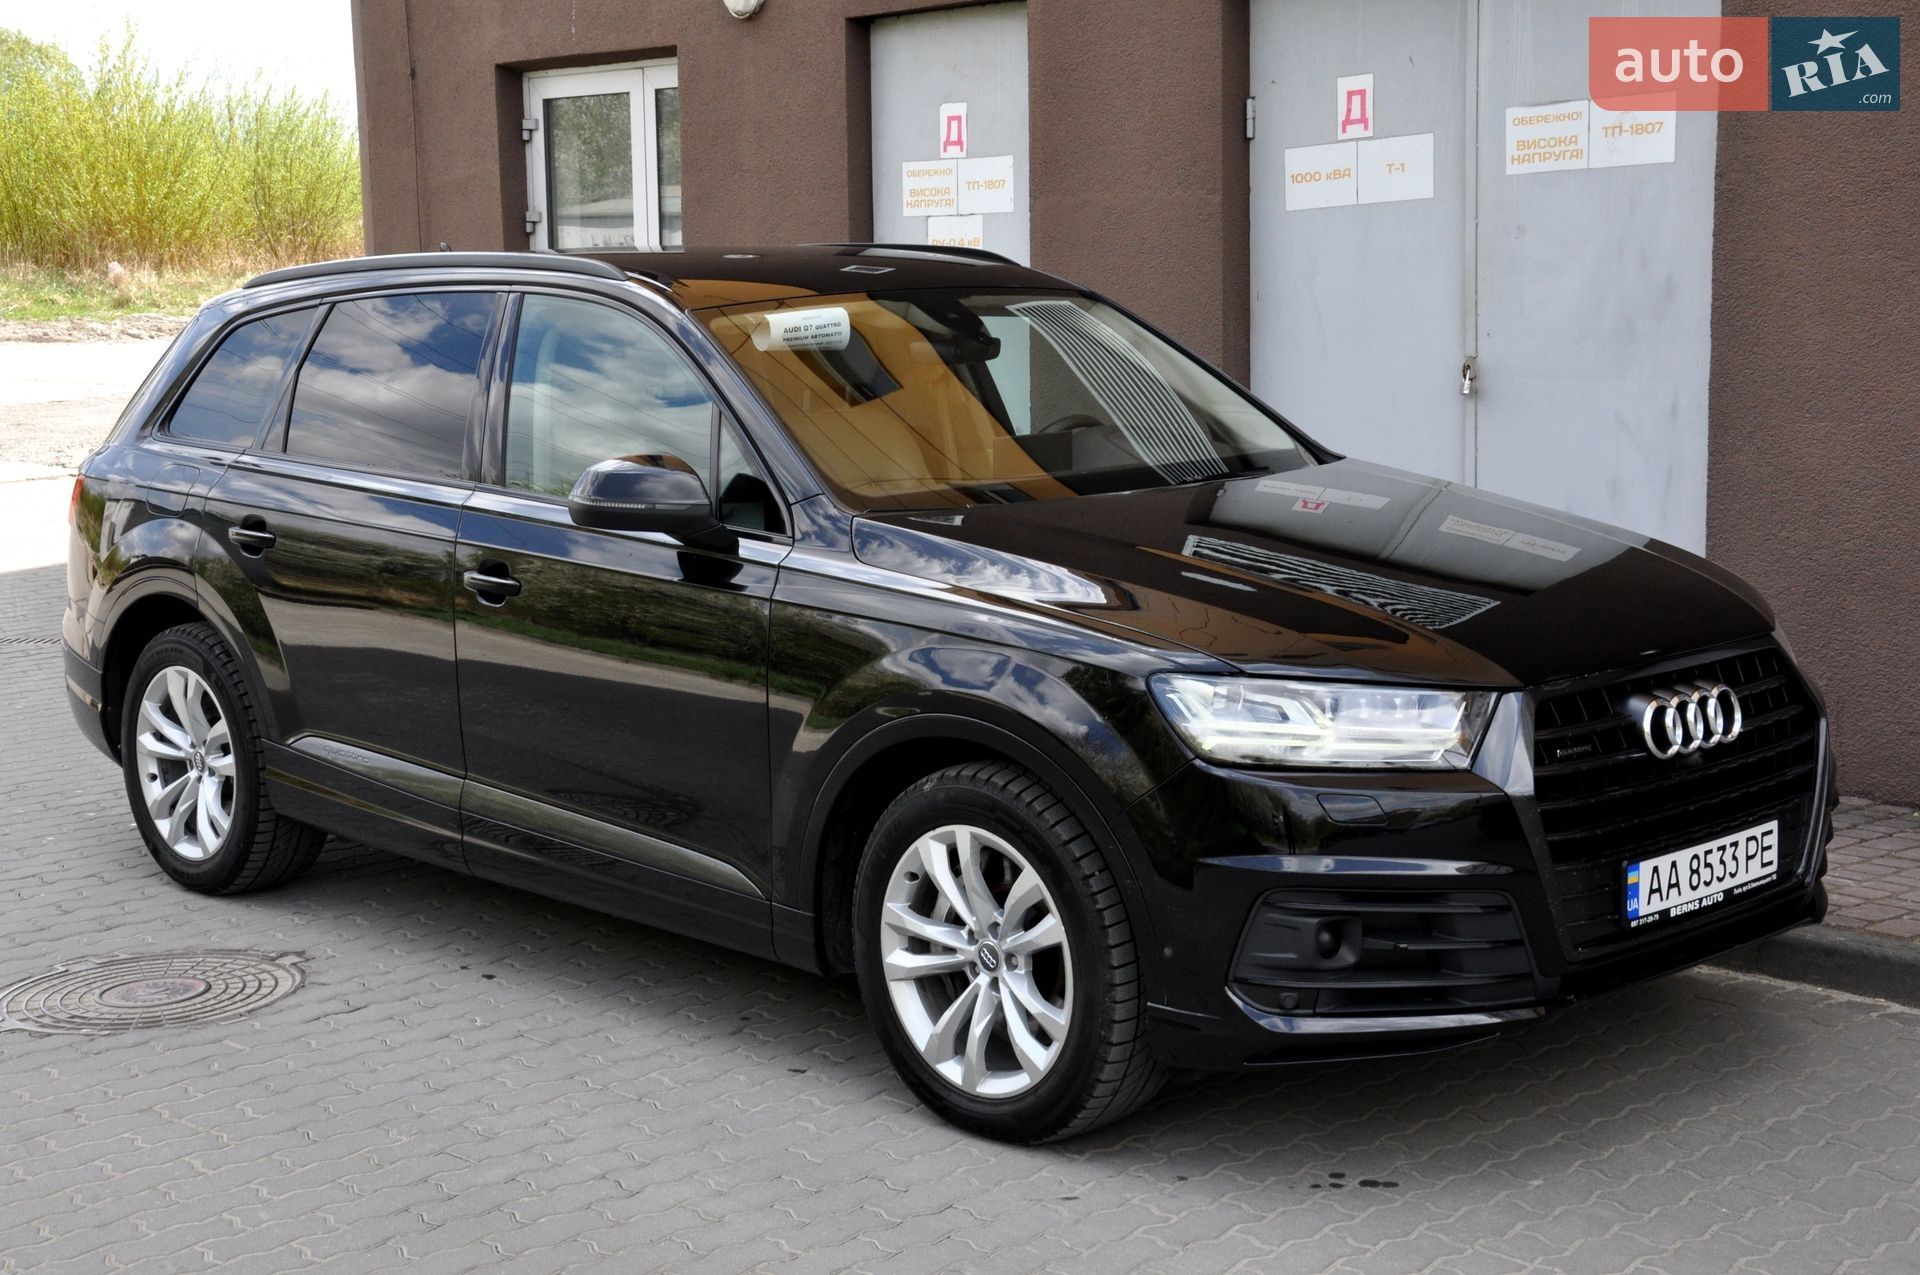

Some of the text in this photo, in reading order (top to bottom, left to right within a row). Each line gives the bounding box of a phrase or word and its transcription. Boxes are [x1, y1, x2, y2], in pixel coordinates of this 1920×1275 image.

[1341, 88, 1369, 134] Д
[1512, 111, 1583, 127] ОБЕРЕЖНО!
[943, 115, 964, 152] Д
[1601, 122, 1665, 139] ТП-1807
[1516, 135, 1579, 151] ВИСОКА
[1511, 149, 1584, 166] НАПРУГА!
[906, 168, 953, 178] ОБЕРЕЖНО!
[1290, 171, 1322, 185] 1000
[909, 187, 951, 198] ВИСОКА
[966, 179, 1006, 191] ТП-1807
[906, 198, 954, 209] НАПРУГА!
[783, 321, 842, 334] AUDI Q7 QUATTRO
[1647, 860, 1682, 906] AA
[1688, 840, 1740, 892] 8533
[1745, 829, 1774, 874] PE
[1627, 897, 1639, 912] UA
[1670, 892, 1724, 918] BERNS AUTO
